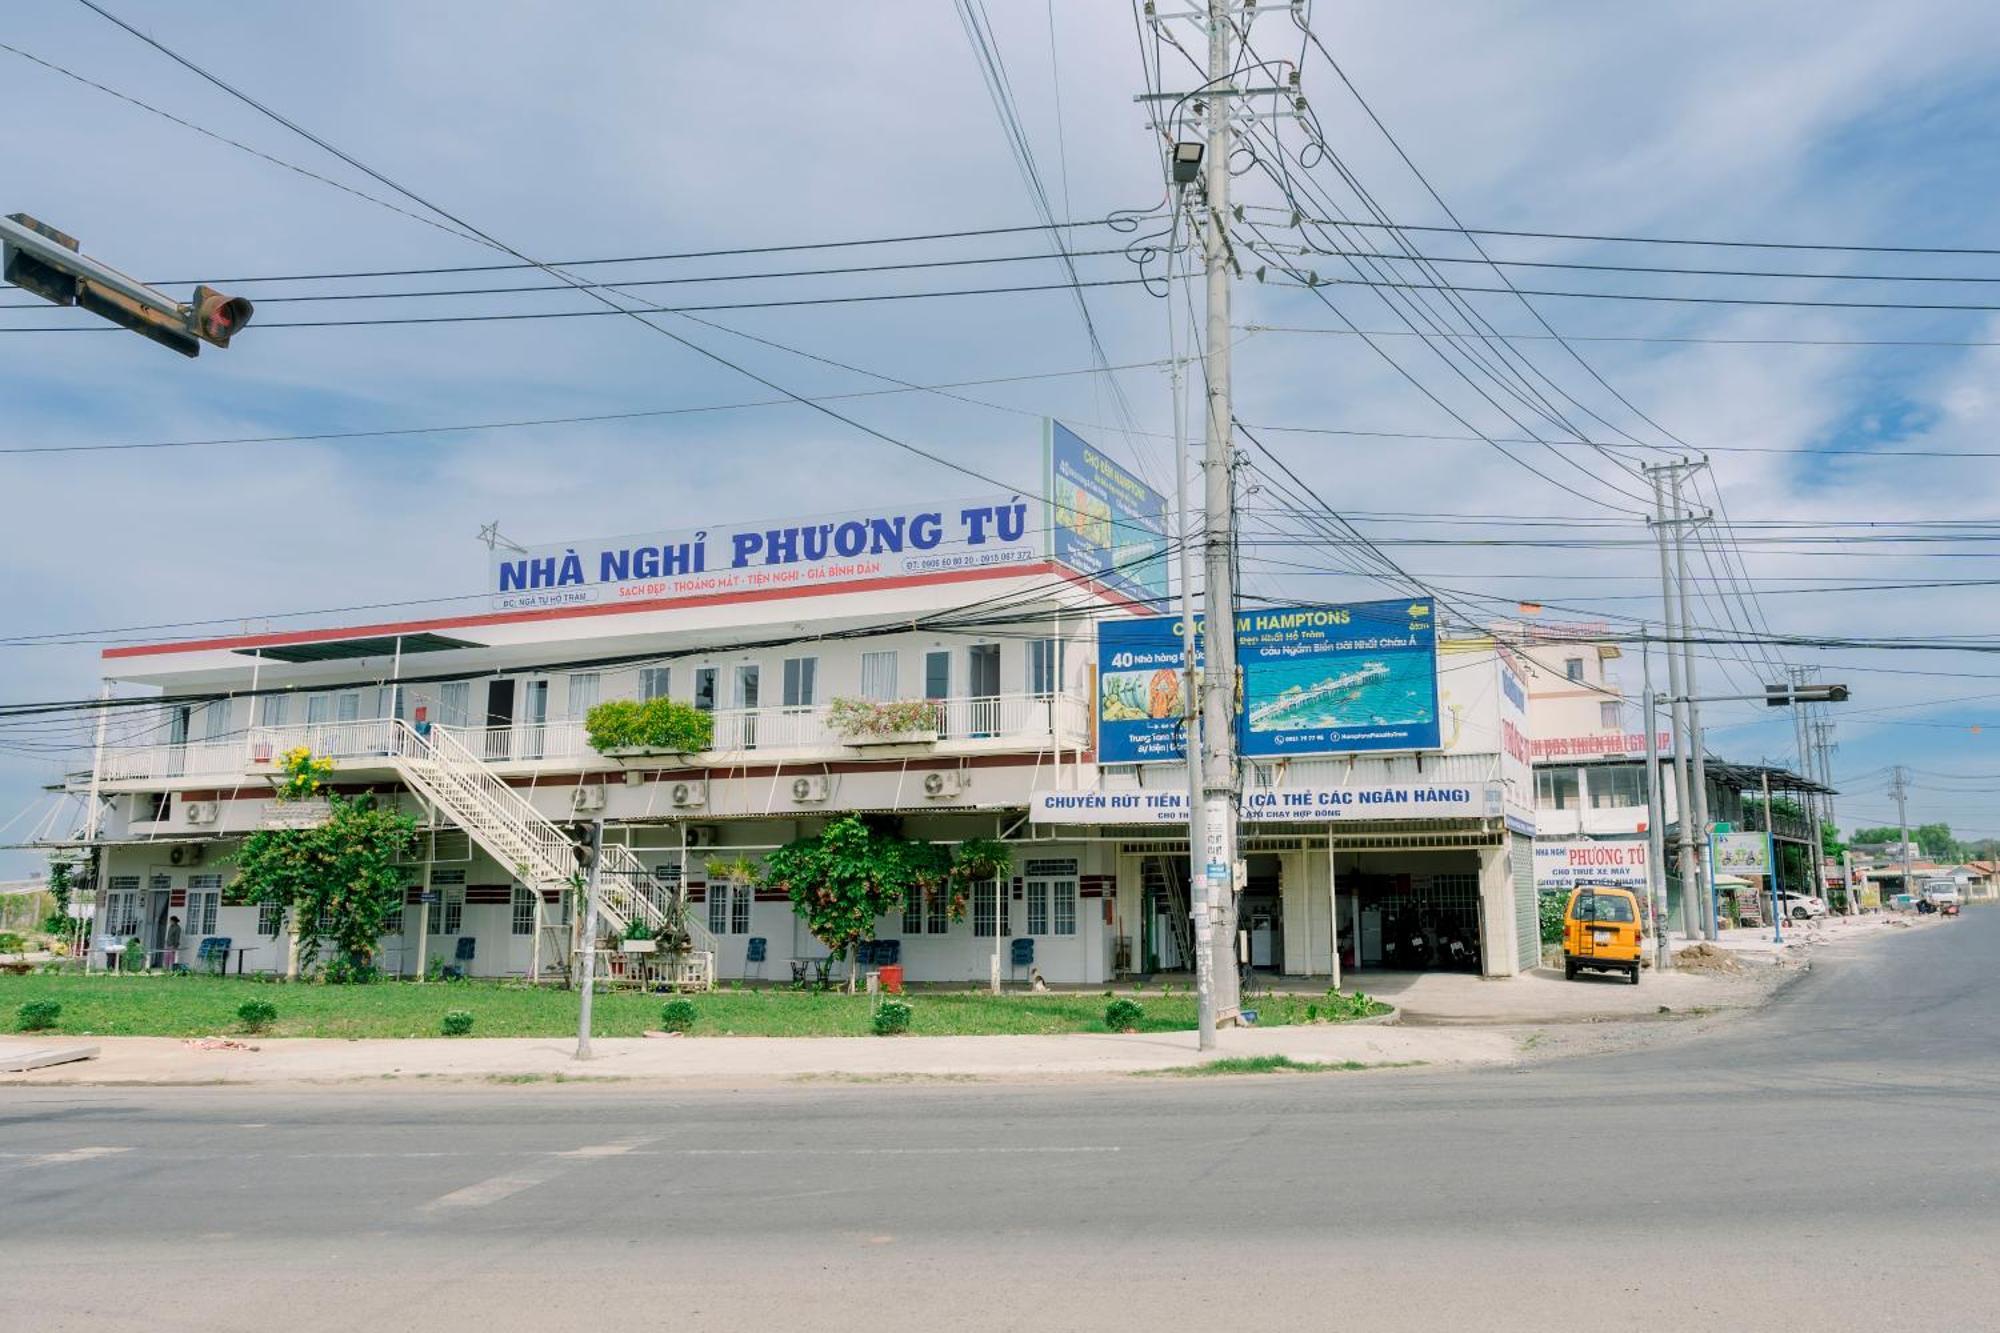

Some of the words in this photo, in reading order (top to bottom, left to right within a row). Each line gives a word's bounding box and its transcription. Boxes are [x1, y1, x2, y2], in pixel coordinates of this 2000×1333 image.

[500, 549, 584, 591] NHÀ
[600, 531, 707, 581] NGHỈ
[731, 514, 942, 568] PHƯƠNG
[961, 495, 1027, 545] TÚ
[1256, 609, 1351, 631] HAMPTONS
[1112, 652, 1133, 668] 40
[1155, 652, 1178, 665] hàng
[1111, 793, 1140, 807] RÚT
[1282, 789, 1313, 805] THẺ
[1319, 789, 1352, 805] CÁC
[1359, 788, 1408, 804] NGÂN
[1414, 787, 1470, 803] HÀNG)
[1569, 846, 1623, 865] PHƯƠNG
[1628, 843, 1645, 864] TÚ
[1552, 868, 1570, 876] CHO
